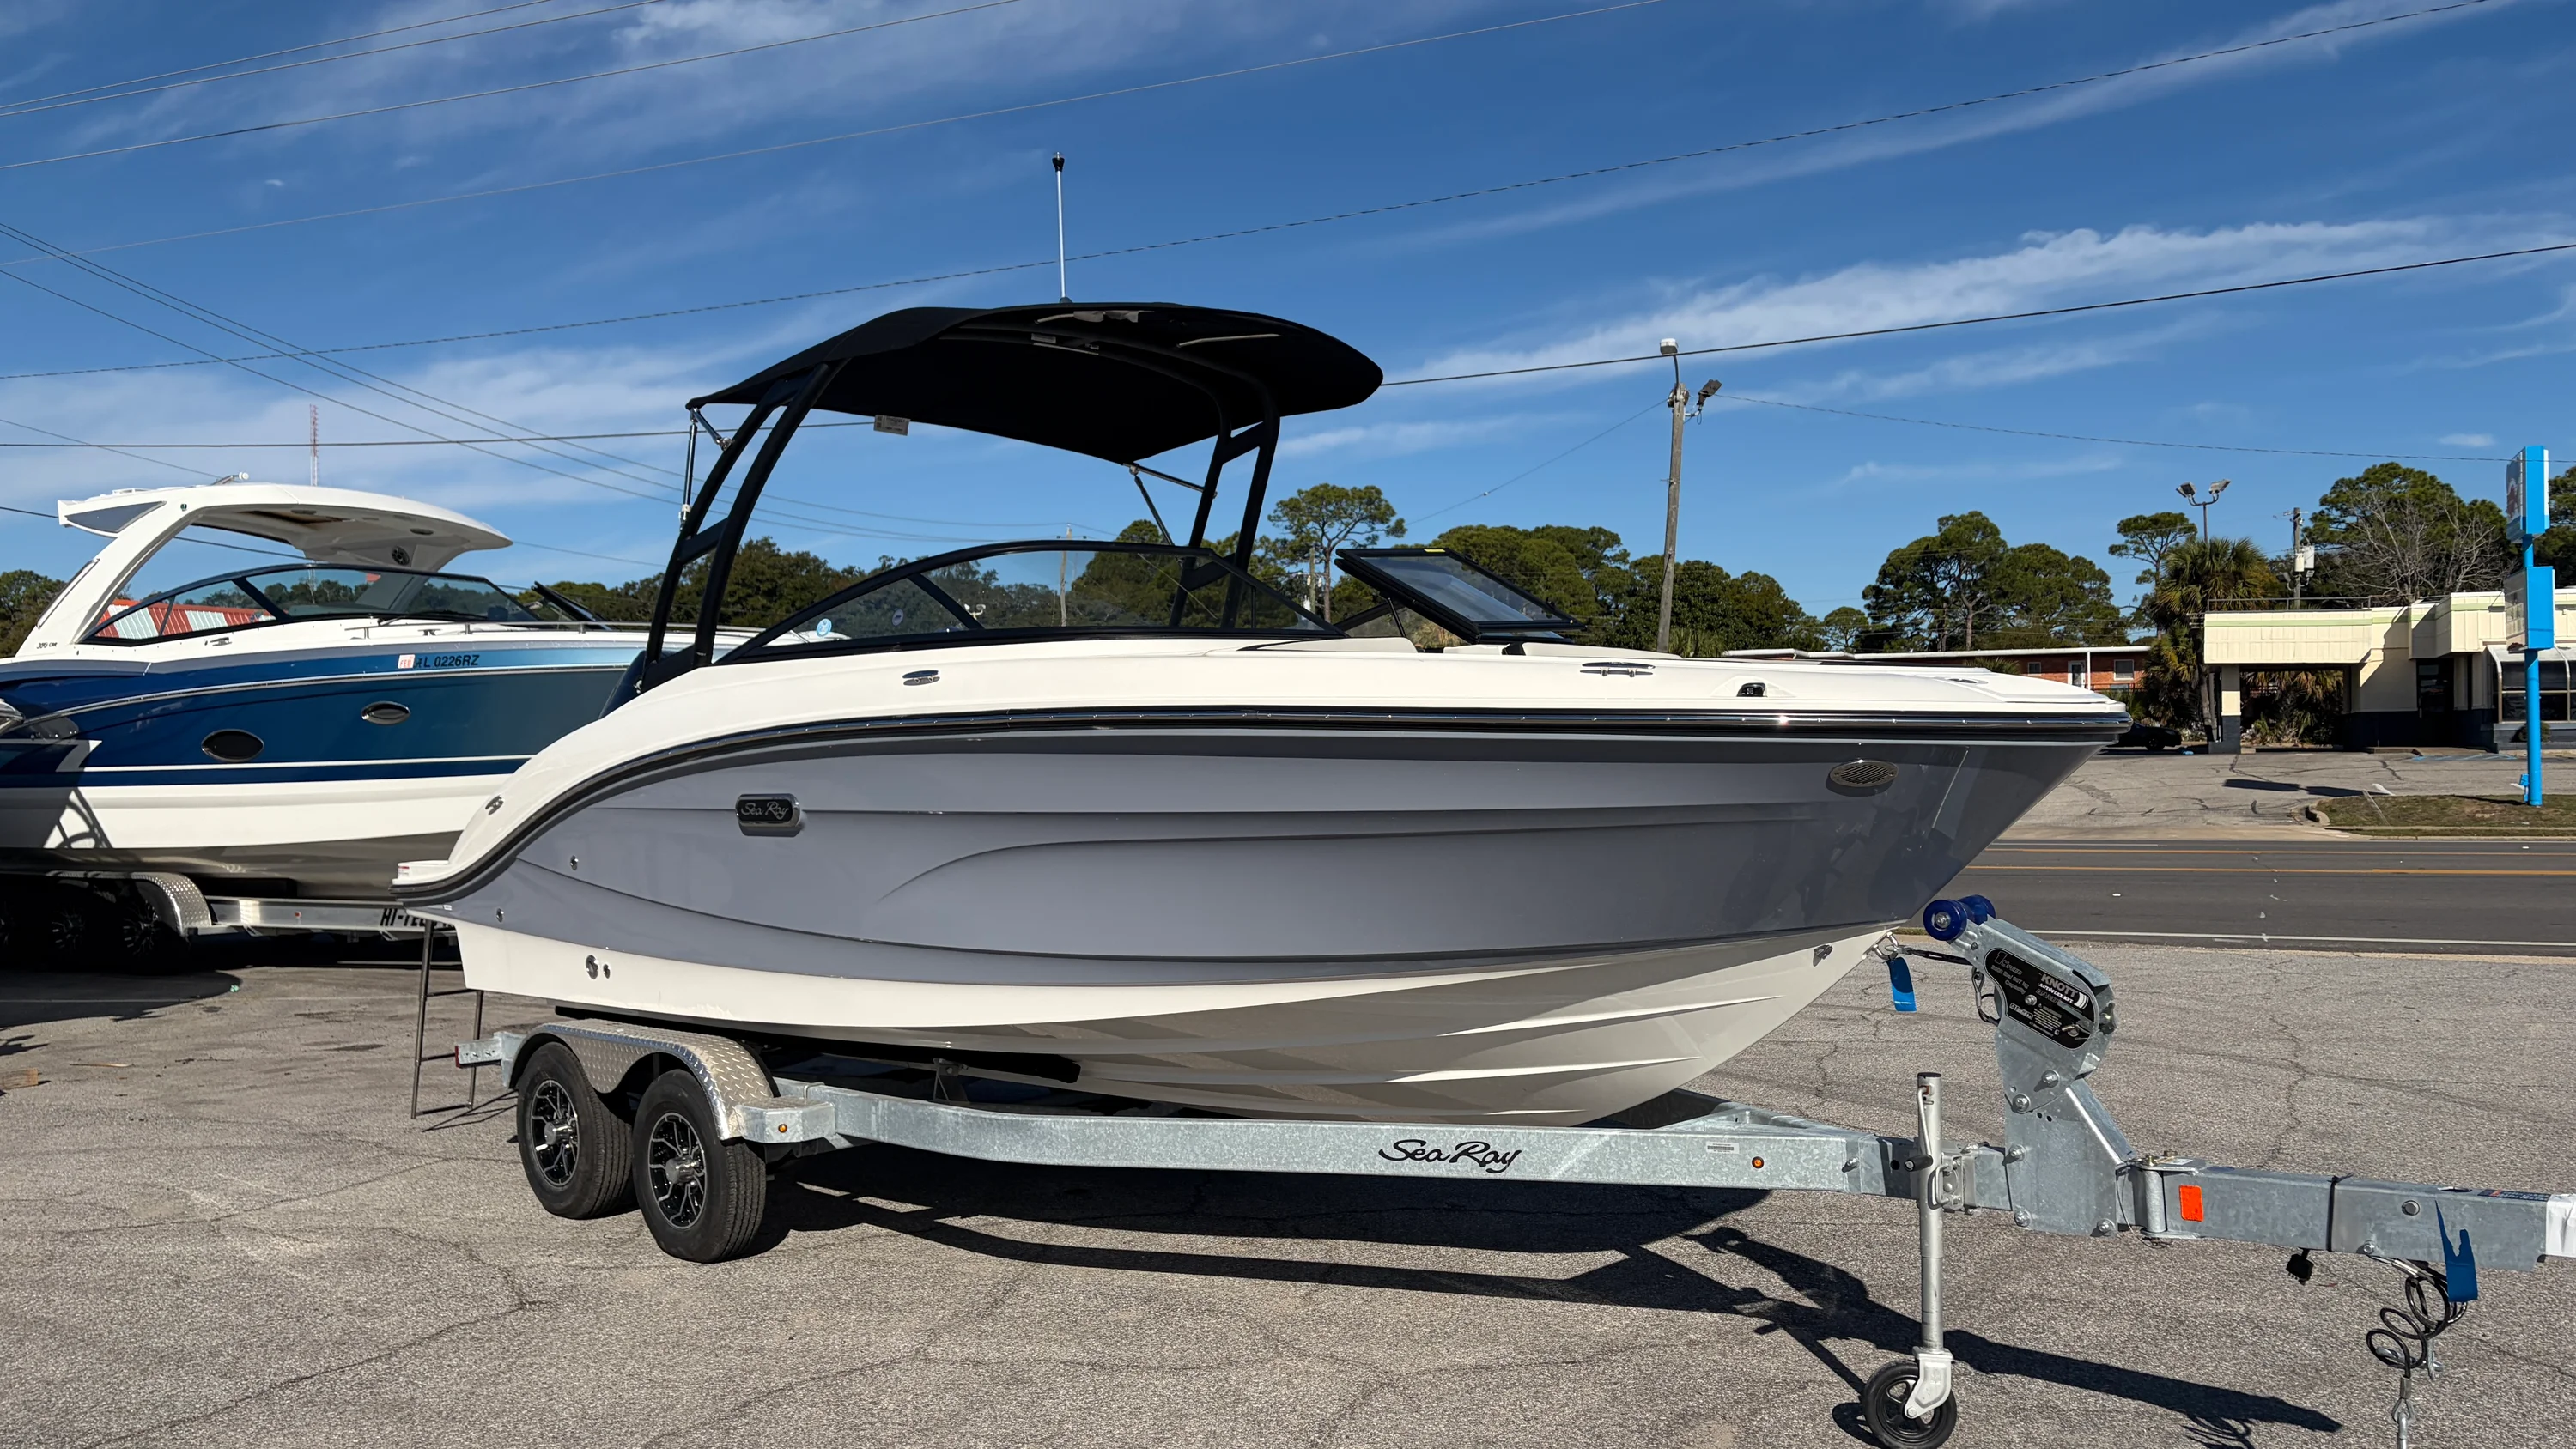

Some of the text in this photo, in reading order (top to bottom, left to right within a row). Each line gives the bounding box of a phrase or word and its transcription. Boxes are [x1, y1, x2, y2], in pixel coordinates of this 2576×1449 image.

[434, 655, 480, 667] 0226RZ
[741, 801, 789, 820] Sea Ray
[2040, 973, 2079, 997] KNOTT
[1378, 1139, 1522, 1173] Sea Ray
